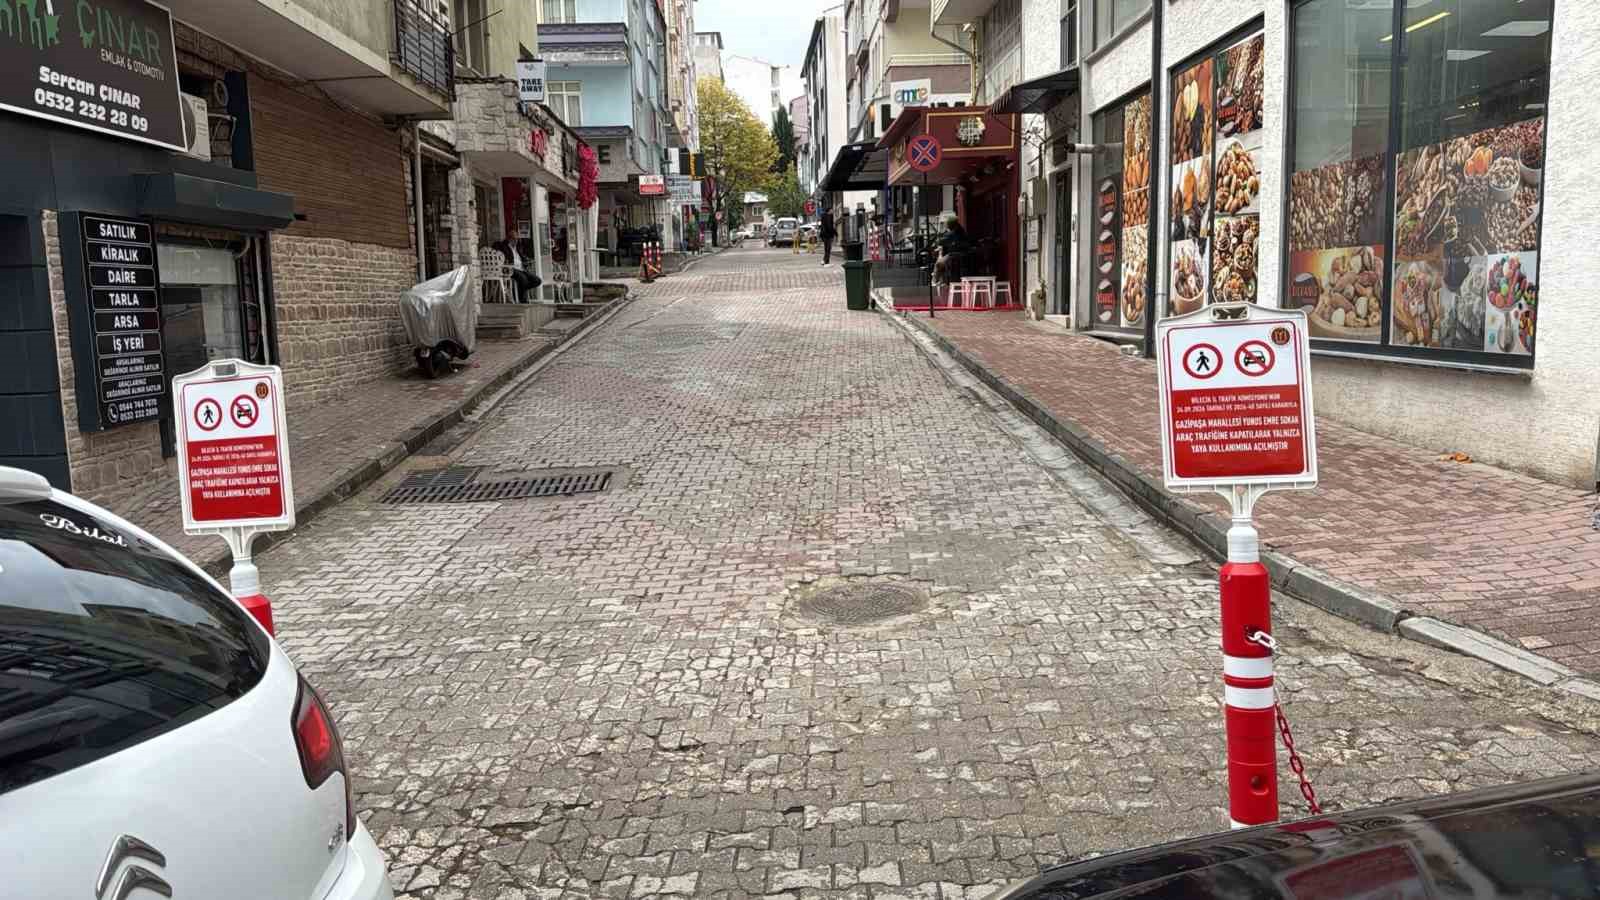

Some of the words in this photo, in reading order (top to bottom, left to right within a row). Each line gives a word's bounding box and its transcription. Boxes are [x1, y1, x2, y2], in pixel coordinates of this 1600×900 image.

[76, 0, 163, 65] ÇINAR
[101, 48, 126, 69] EMLAK
[127, 58, 133, 71] &
[39, 65, 95, 97] Sercan
[99, 84, 141, 110] ÇINAR
[521, 78, 542, 86] TAKE
[895, 88, 928, 103] emre
[34, 88, 75, 113] 0532
[79, 100, 107, 121] 232
[110, 108, 127, 127] 28
[131, 116, 149, 132] 09
[100, 223, 137, 239] SATILIK
[101, 243, 139, 262] KİRALIK
[108, 267, 137, 284] DAİRE
[109, 293, 139, 306] TARLA
[114, 315, 139, 328] ARSA
[113, 335, 123, 353] İŞ
[123, 334, 144, 350] YERİ
[1175, 418, 1207, 430] GAZİPAŞA
[1208, 417, 1241, 428] MAHALLESİ
[1243, 416, 1263, 426] YUNUS
[1263, 416, 1279, 425] EMRE
[1176, 432, 1194, 442] ARAÇ
[1229, 429, 1272, 440] KAPATILARAK
[1272, 428, 1300, 437] YALNIZCA
[1191, 444, 1207, 453] YAYA
[1208, 442, 1252, 453] KULLANIMINA
